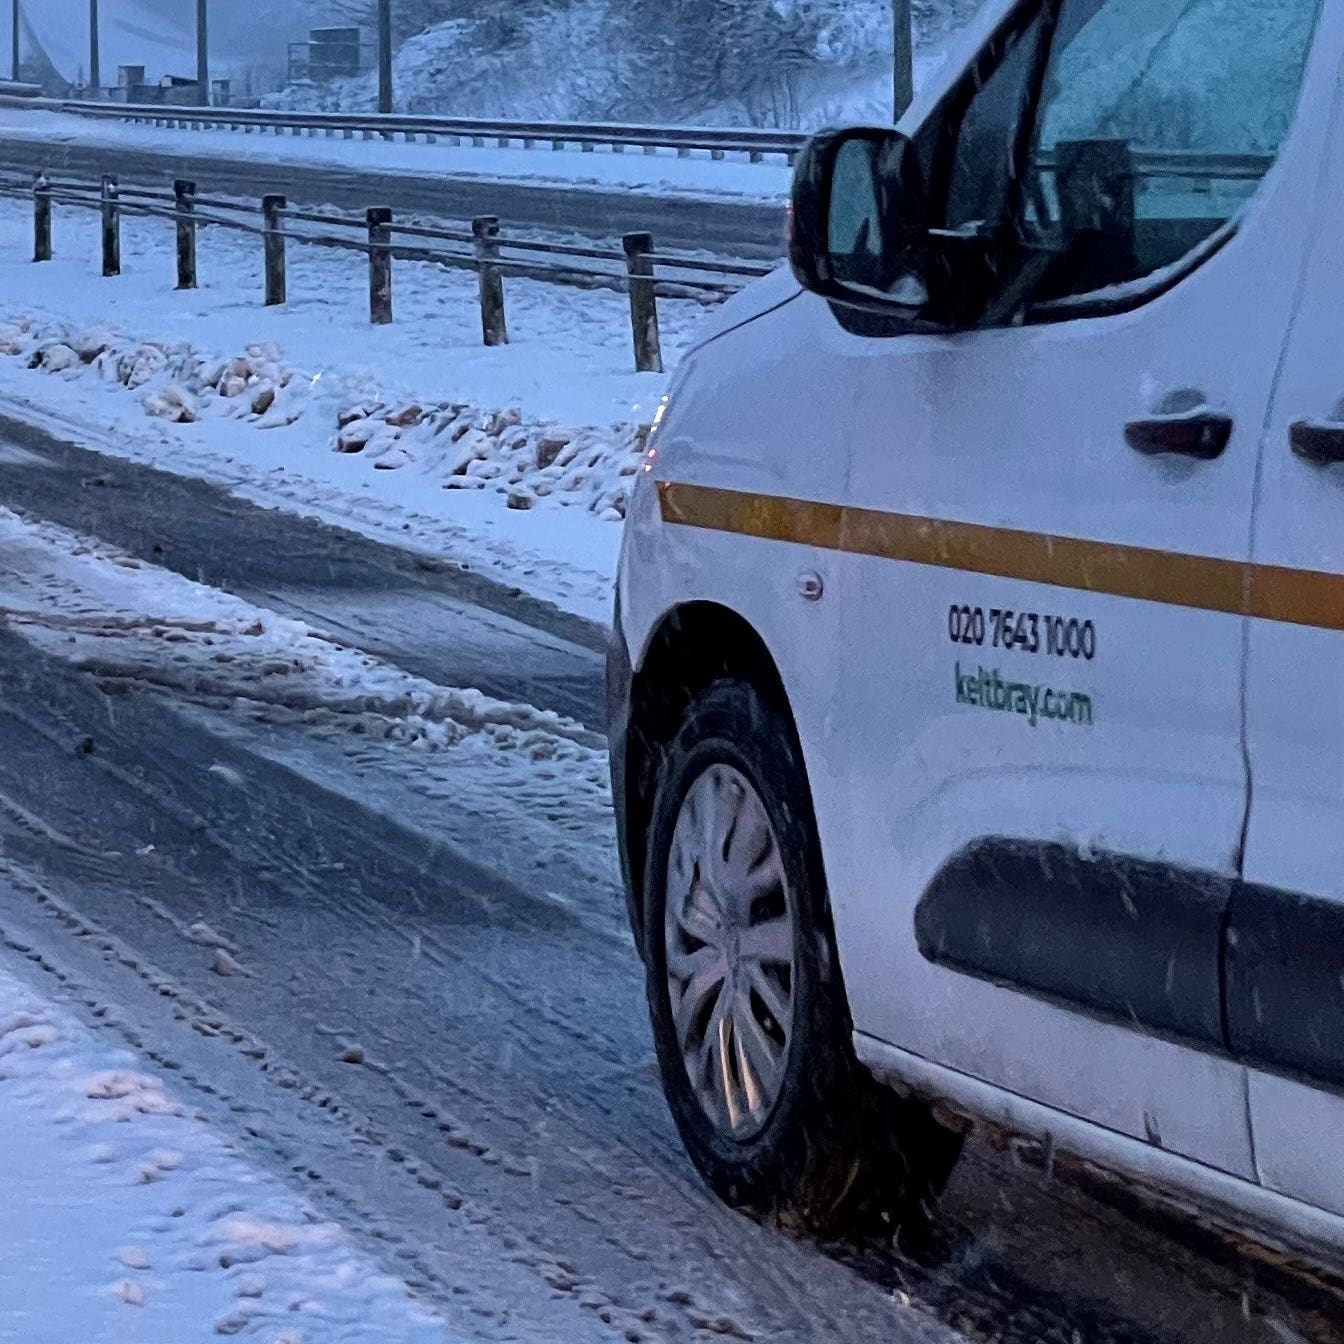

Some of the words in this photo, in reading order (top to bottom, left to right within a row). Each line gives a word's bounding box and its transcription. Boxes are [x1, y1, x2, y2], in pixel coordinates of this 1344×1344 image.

[949, 605, 984, 645] 020
[990, 609, 1039, 653] 7643
[1044, 615, 1096, 660] 1000
